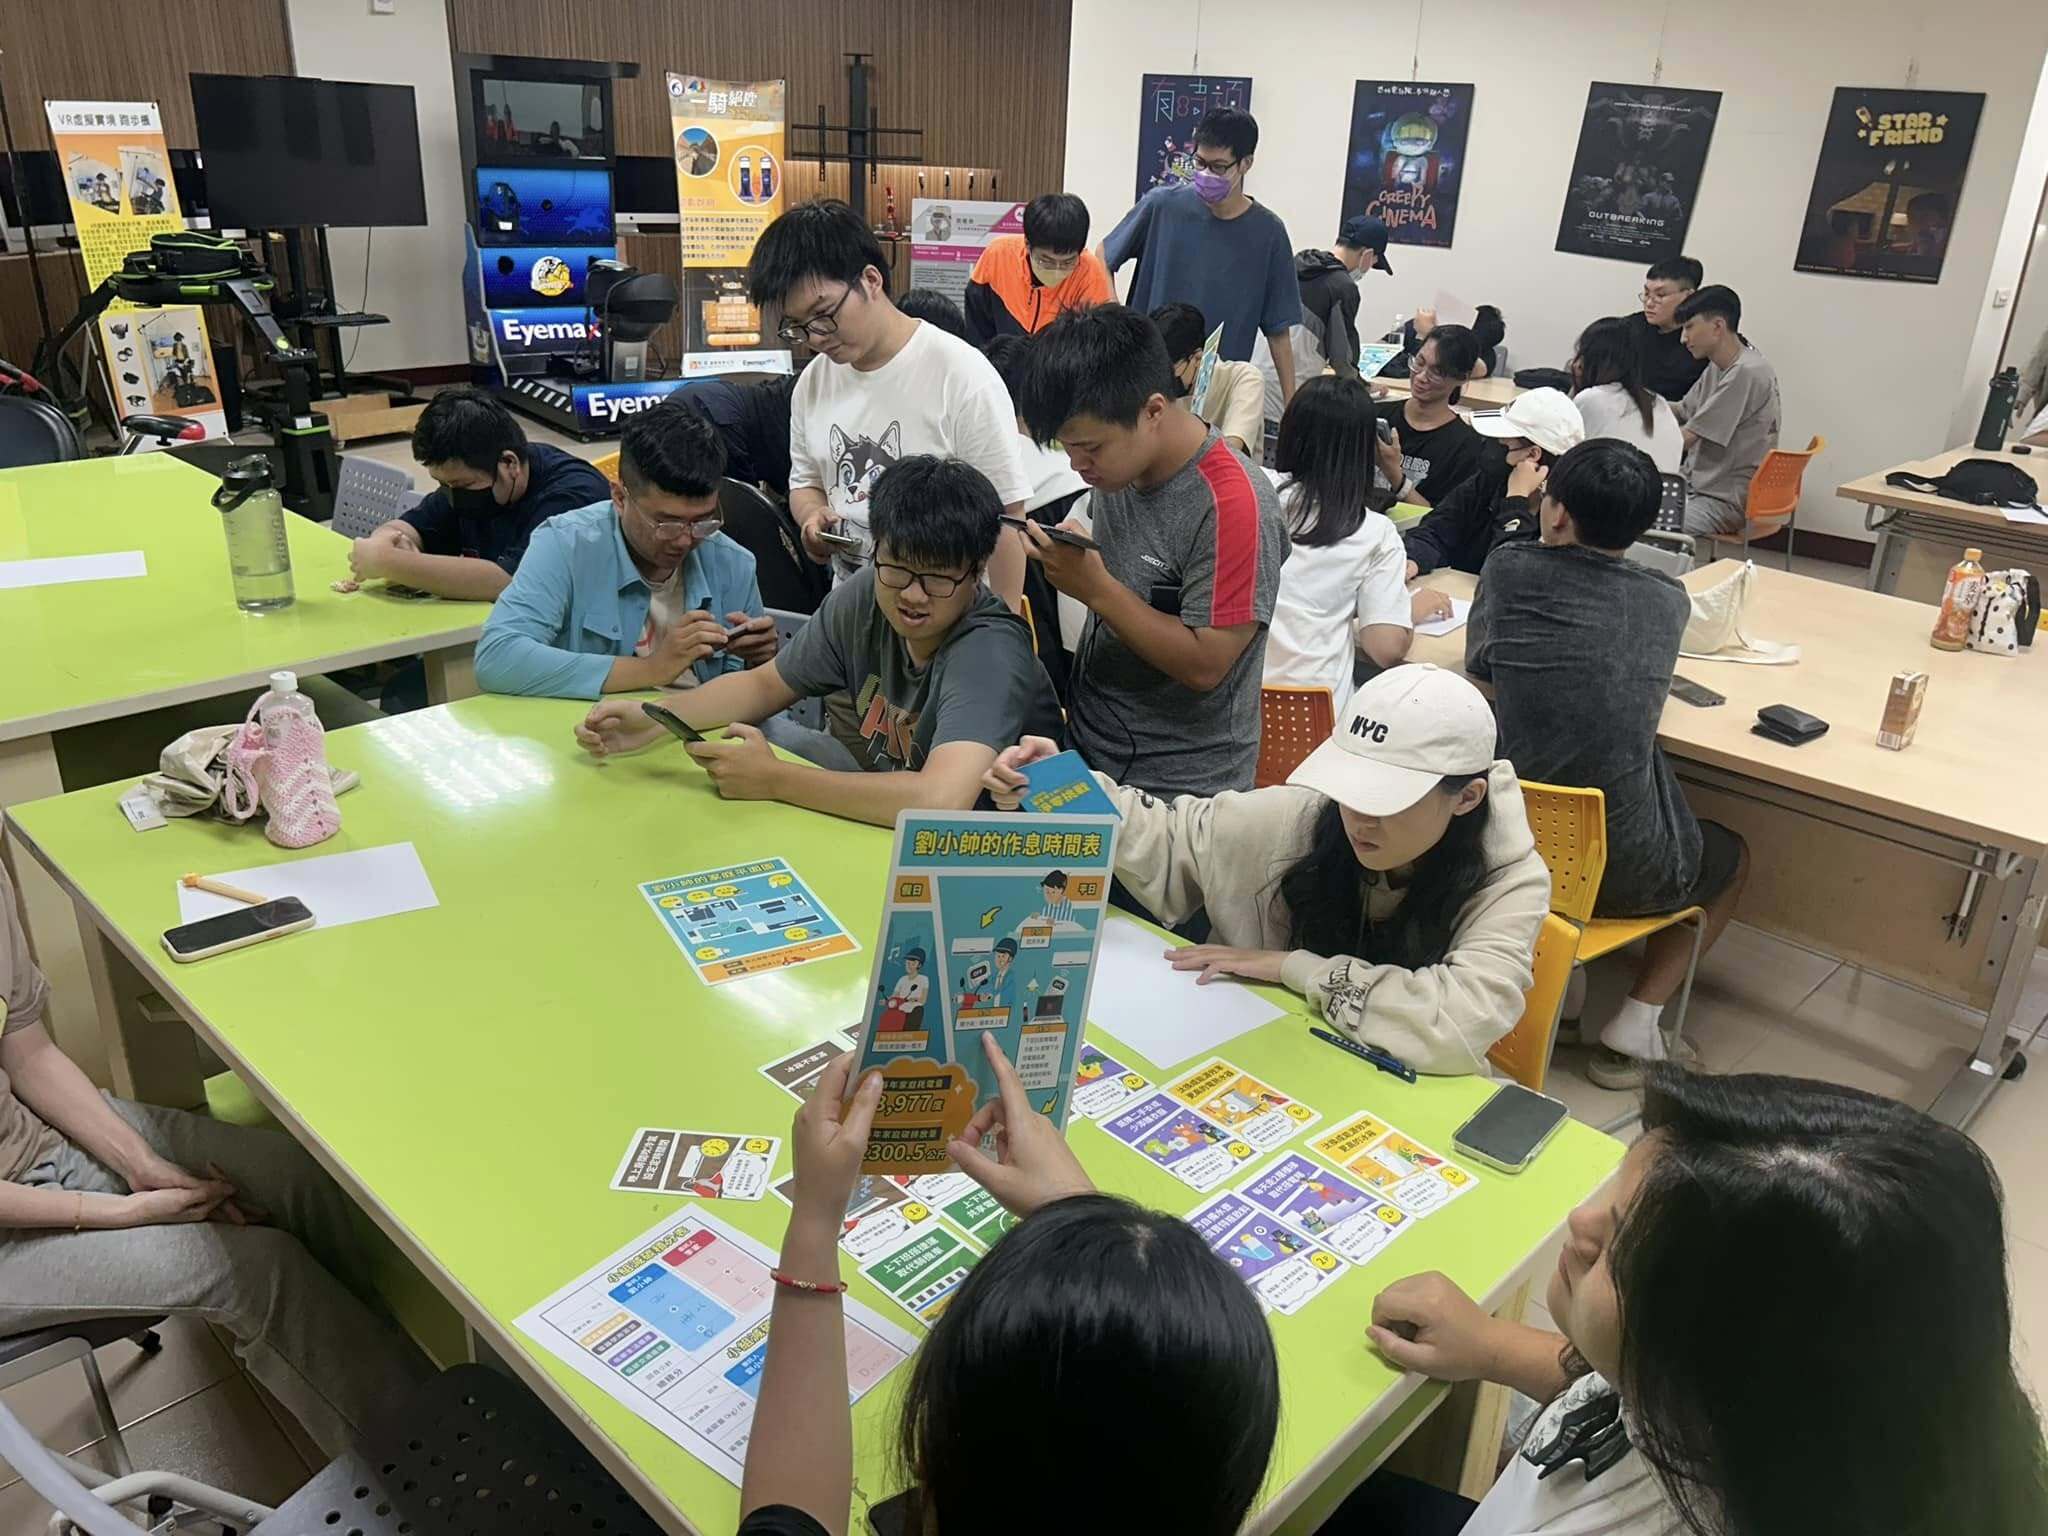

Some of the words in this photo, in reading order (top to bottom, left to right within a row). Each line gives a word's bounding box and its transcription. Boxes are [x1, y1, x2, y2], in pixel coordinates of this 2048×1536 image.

[1878, 112, 1933, 130] STAR
[1869, 127, 1944, 146] FRIEND
[1379, 181, 1430, 208] CREEPY
[1365, 201, 1437, 229] CINEMA
[1588, 210, 1665, 227] OUTBREAKING
[588, 392, 669, 423] Eyem
[1350, 715, 1389, 743] NYC
[913, 830, 1102, 857] 劉小帥的作息時間表
[901, 883, 923, 897] 假日
[1078, 883, 1097, 896] 平日
[607, 1225, 690, 1284] 小組減碳積分表
